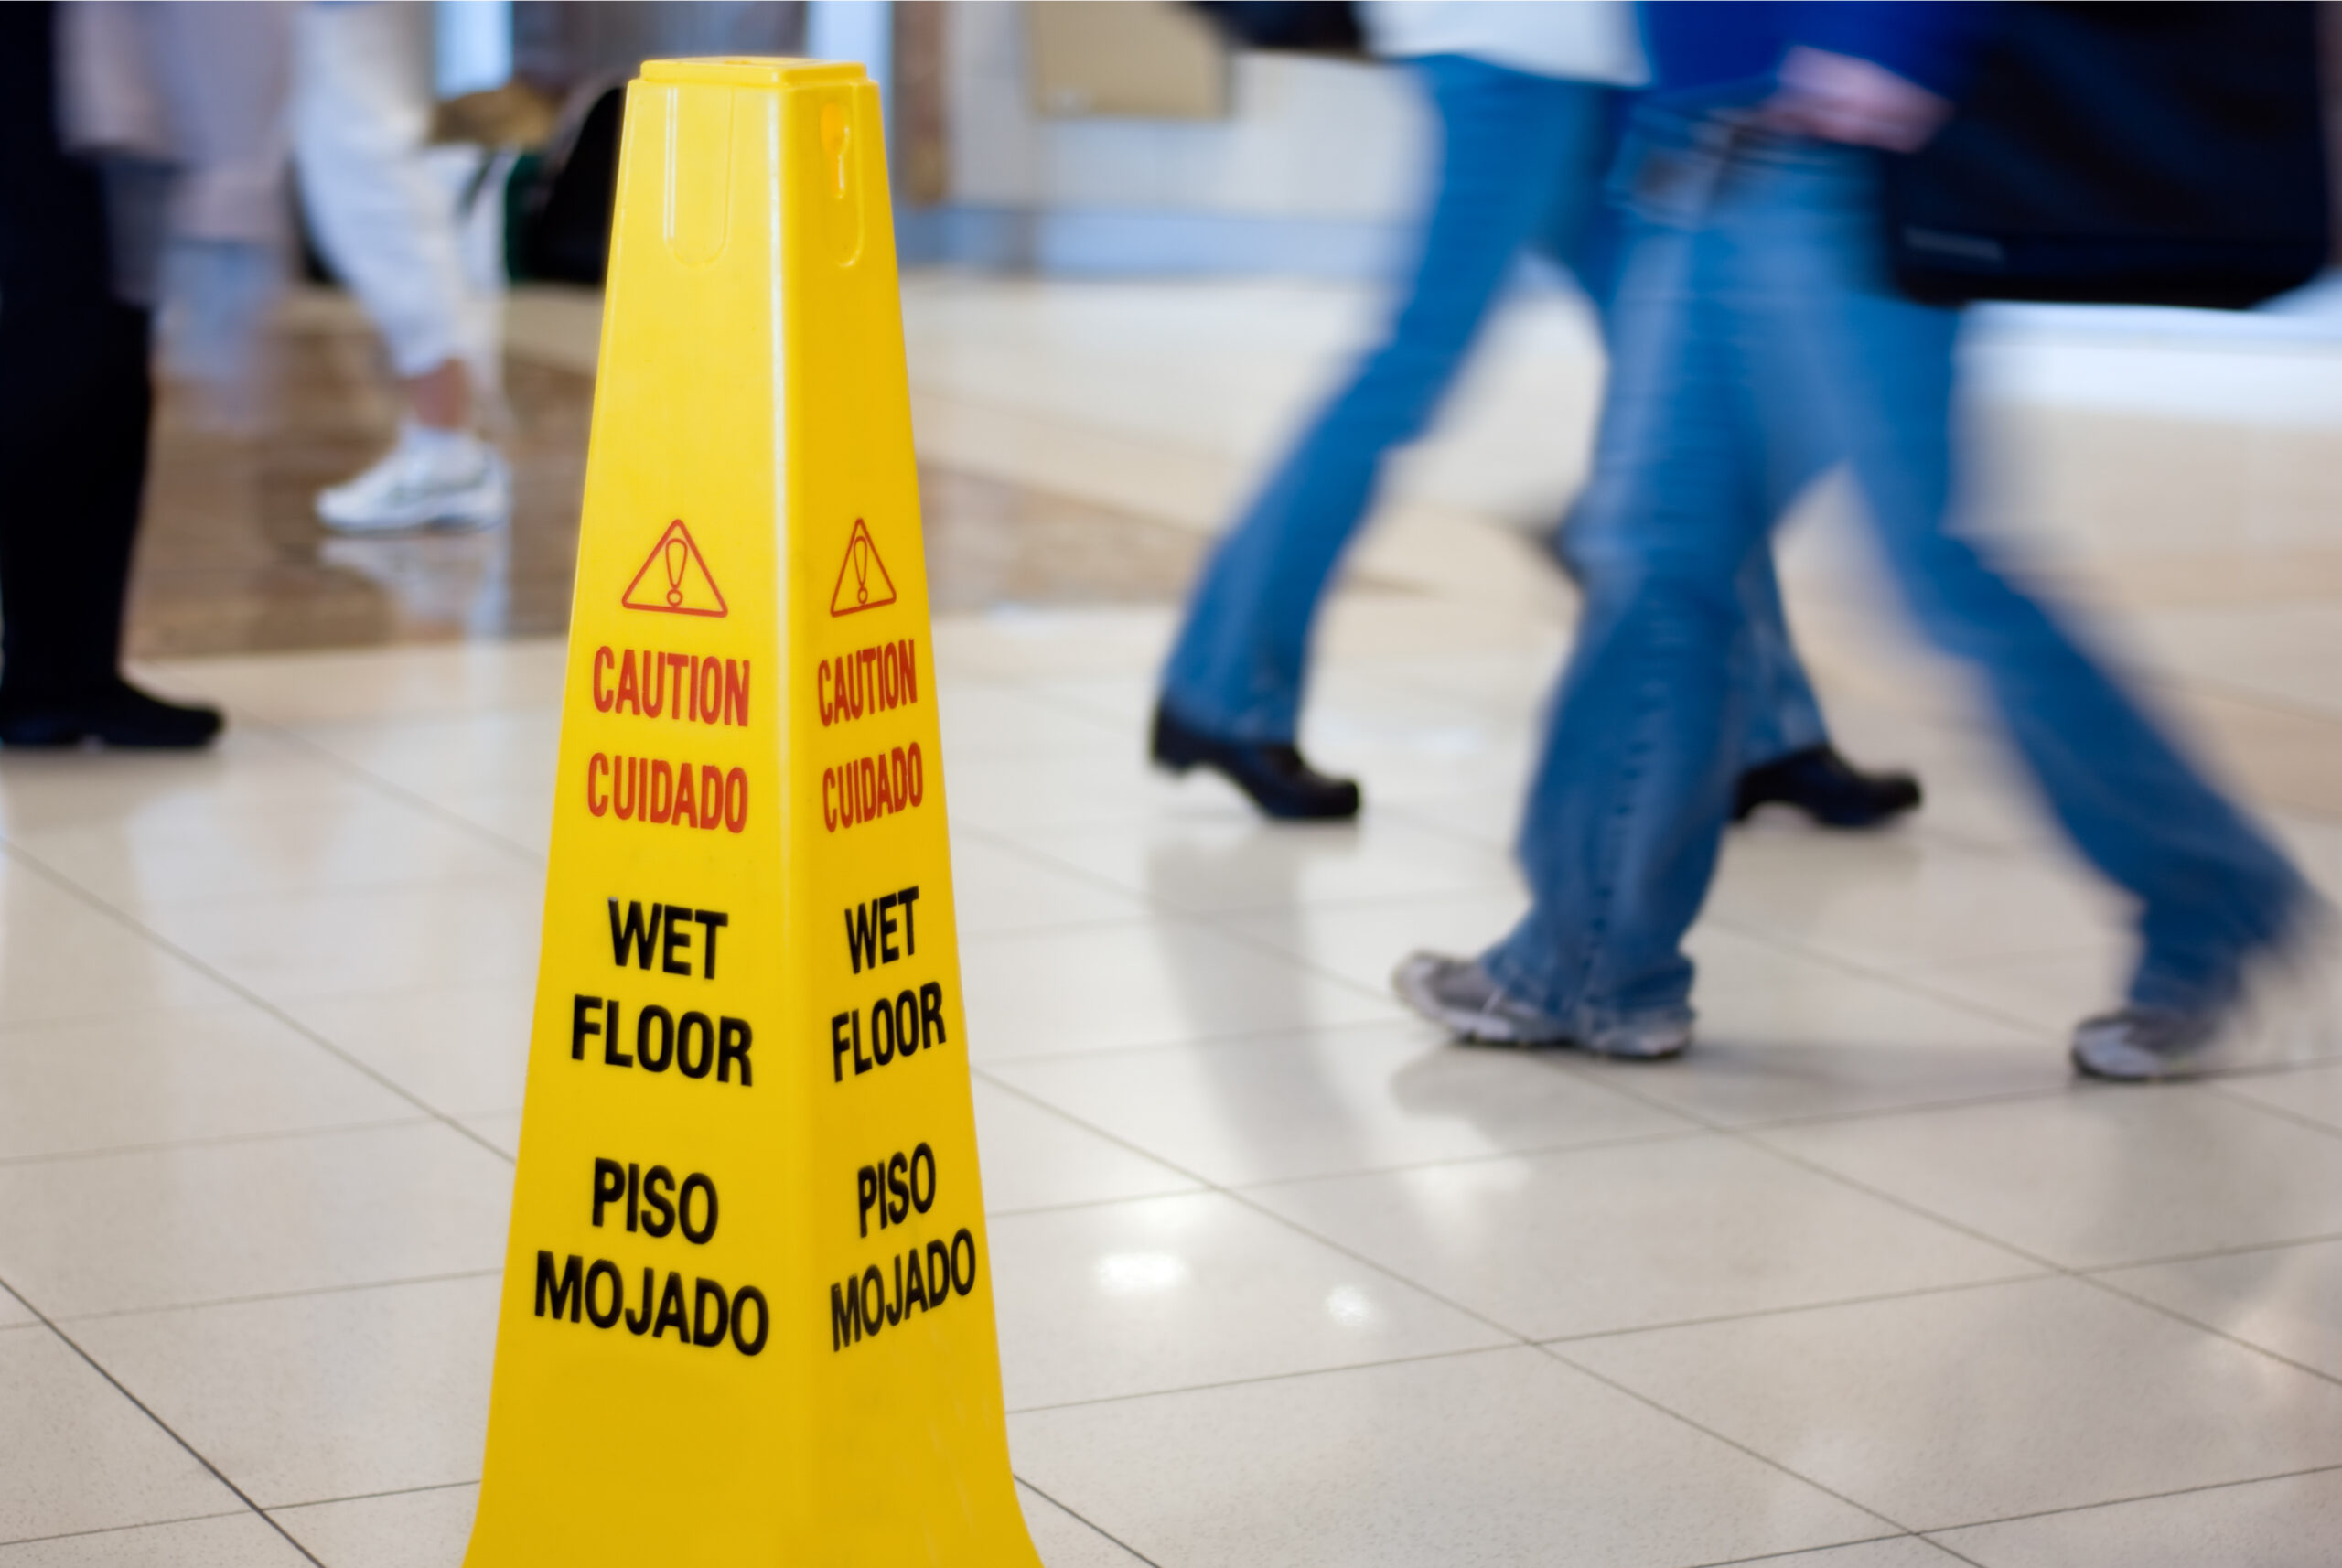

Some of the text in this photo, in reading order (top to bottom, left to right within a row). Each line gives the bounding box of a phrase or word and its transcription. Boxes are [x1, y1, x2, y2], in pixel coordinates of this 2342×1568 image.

[593, 645, 750, 727] CAUTION
[817, 639, 918, 728] CAUTION
[587, 752, 748, 834] CUIDADO
[822, 741, 924, 833] CUIDADO
[607, 897, 729, 981] WET
[843, 885, 920, 975] WET
[571, 993, 753, 1088] FLOOR
[831, 980, 947, 1084] FLOOR
[591, 1156, 719, 1246] PISO
[856, 1141, 937, 1239] PISO
[533, 1249, 770, 1358] MOJADO
[830, 1227, 977, 1353] MOJADO
